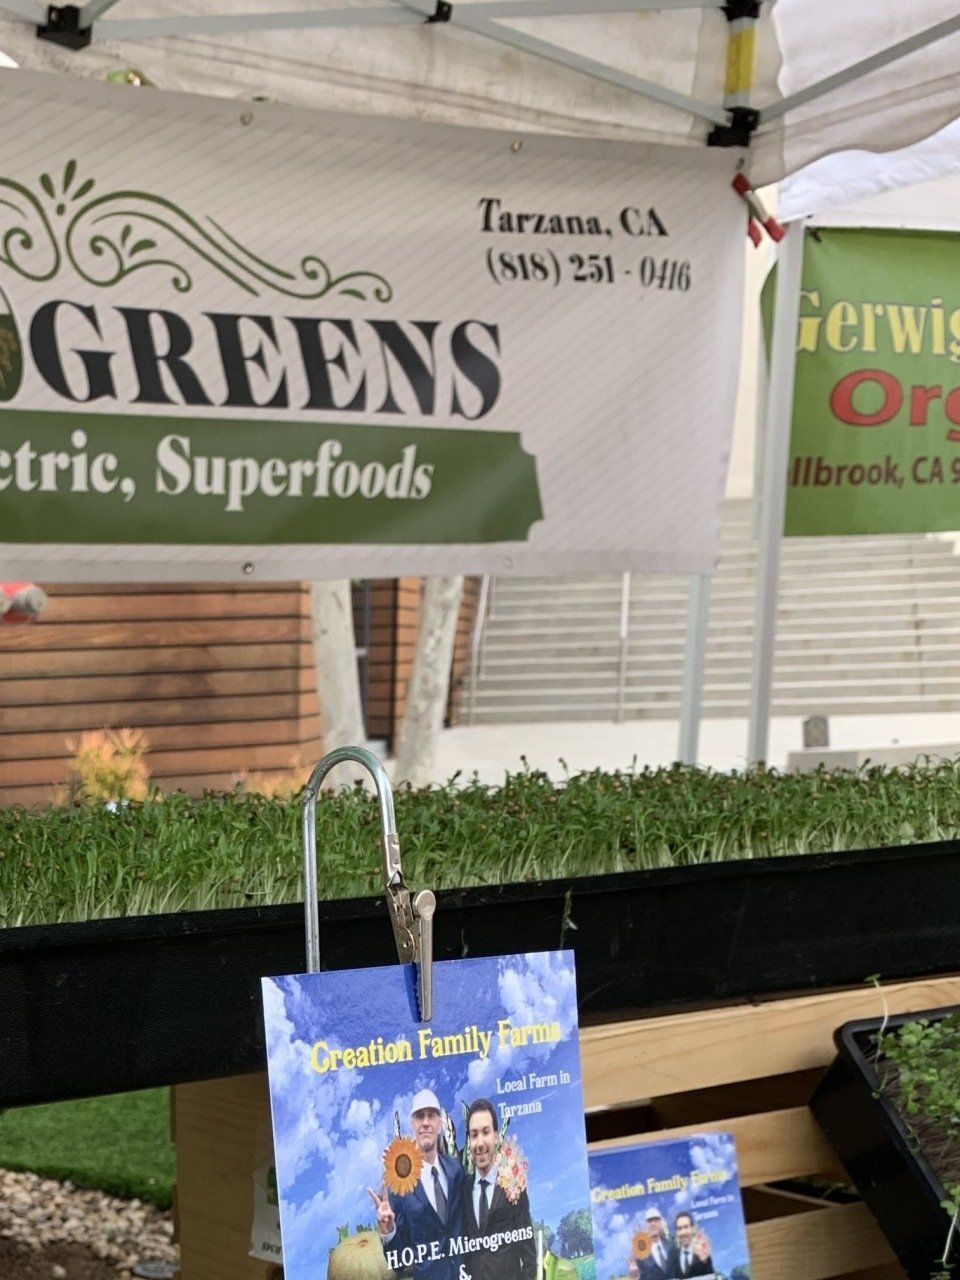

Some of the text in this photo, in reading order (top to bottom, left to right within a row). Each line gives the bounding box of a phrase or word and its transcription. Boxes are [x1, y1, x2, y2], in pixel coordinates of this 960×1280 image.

[479, 198, 670, 238] Tarzana, CA
[486, 247, 562, 287] (818)
[573, 254, 615, 285] 251
[640, 256, 691, 293] 0416
[155, 434, 435, 514] Superfoods
[792, 456, 905, 490] llbrook,
[912, 457, 944, 485] CA
[311, 1018, 562, 1074] Creation Family Farms
[496, 1071, 572, 1095] Local Farm in
[497, 1103, 543, 1120] Tarzana
[385, 1226, 534, 1272] H.O.P.E. Microgreens
